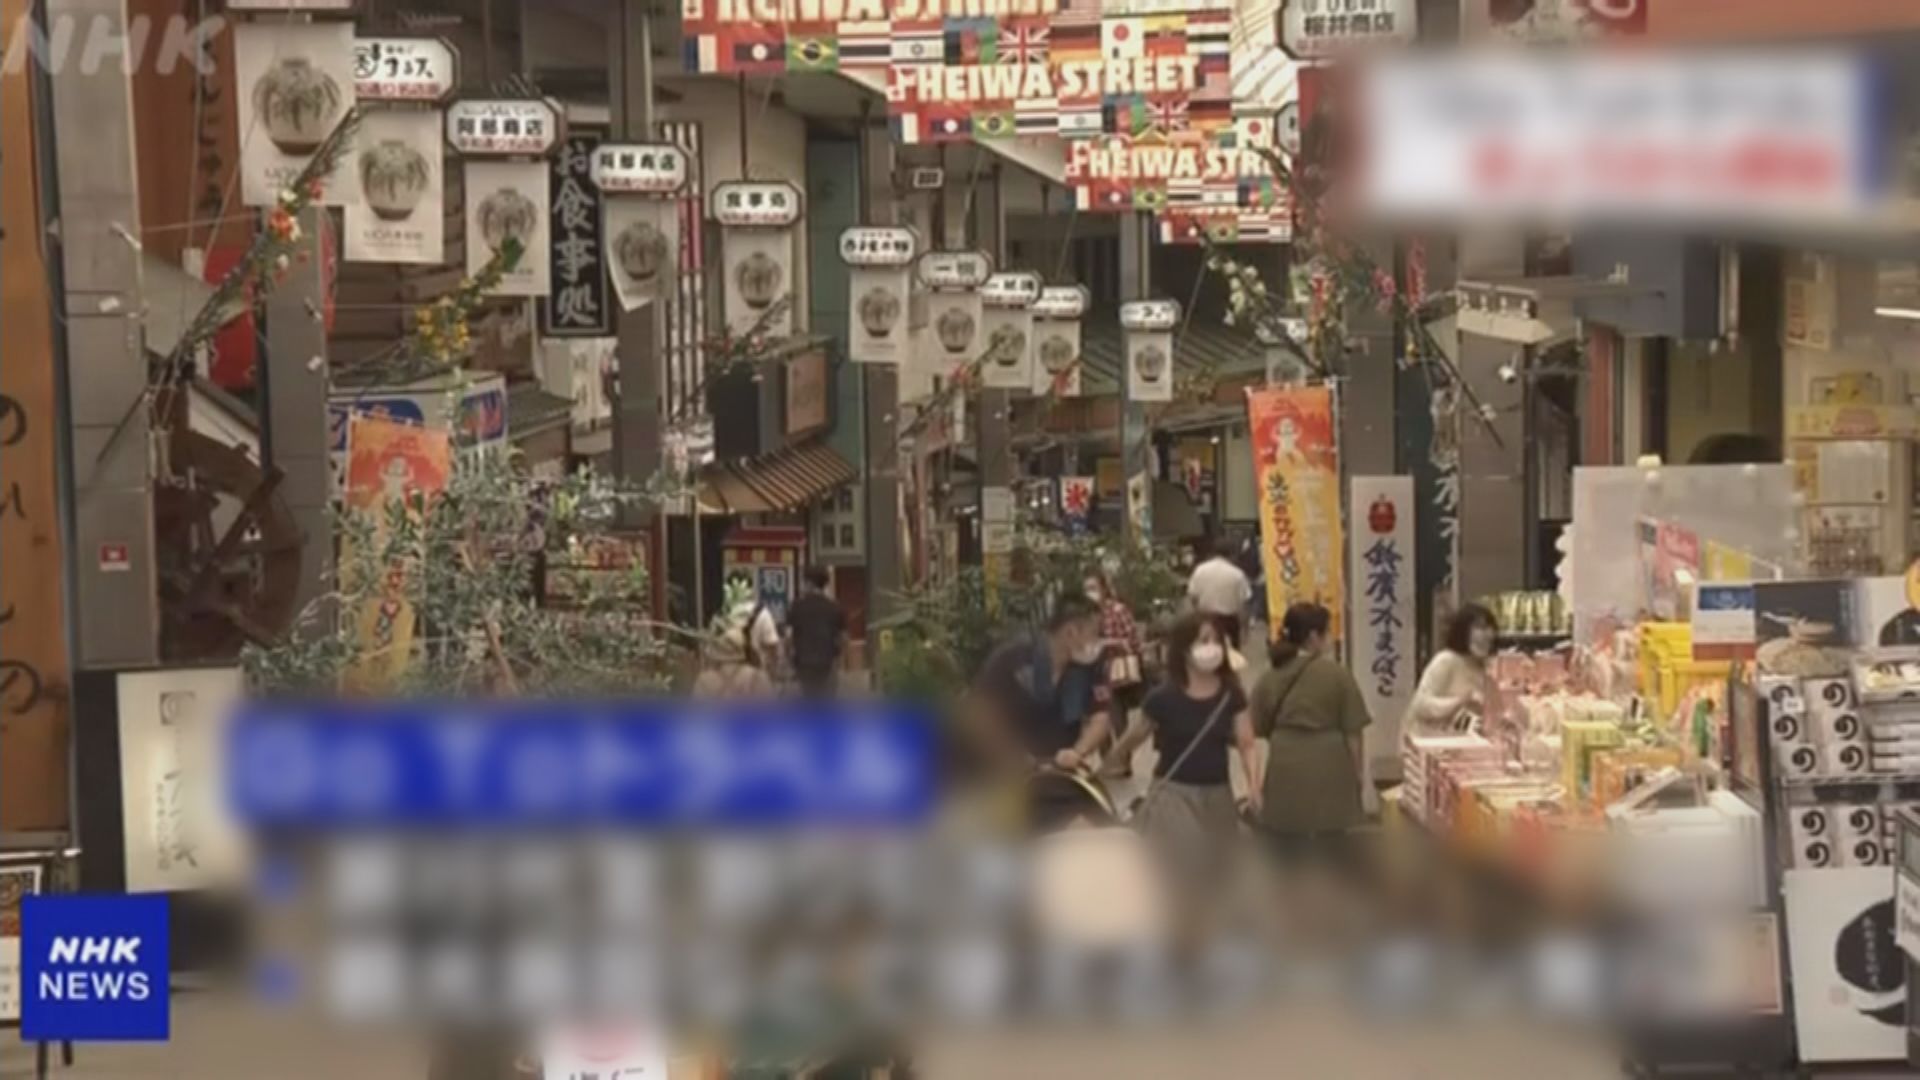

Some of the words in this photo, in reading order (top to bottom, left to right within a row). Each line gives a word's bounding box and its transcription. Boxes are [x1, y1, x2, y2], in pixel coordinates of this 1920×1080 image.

[918, 64, 1051, 99] HEIWA
[1060, 55, 1198, 97] STREET
[457, 118, 544, 136] 阿部商店
[1089, 145, 1199, 178] HEIWA
[552, 141, 598, 326] お食事処
